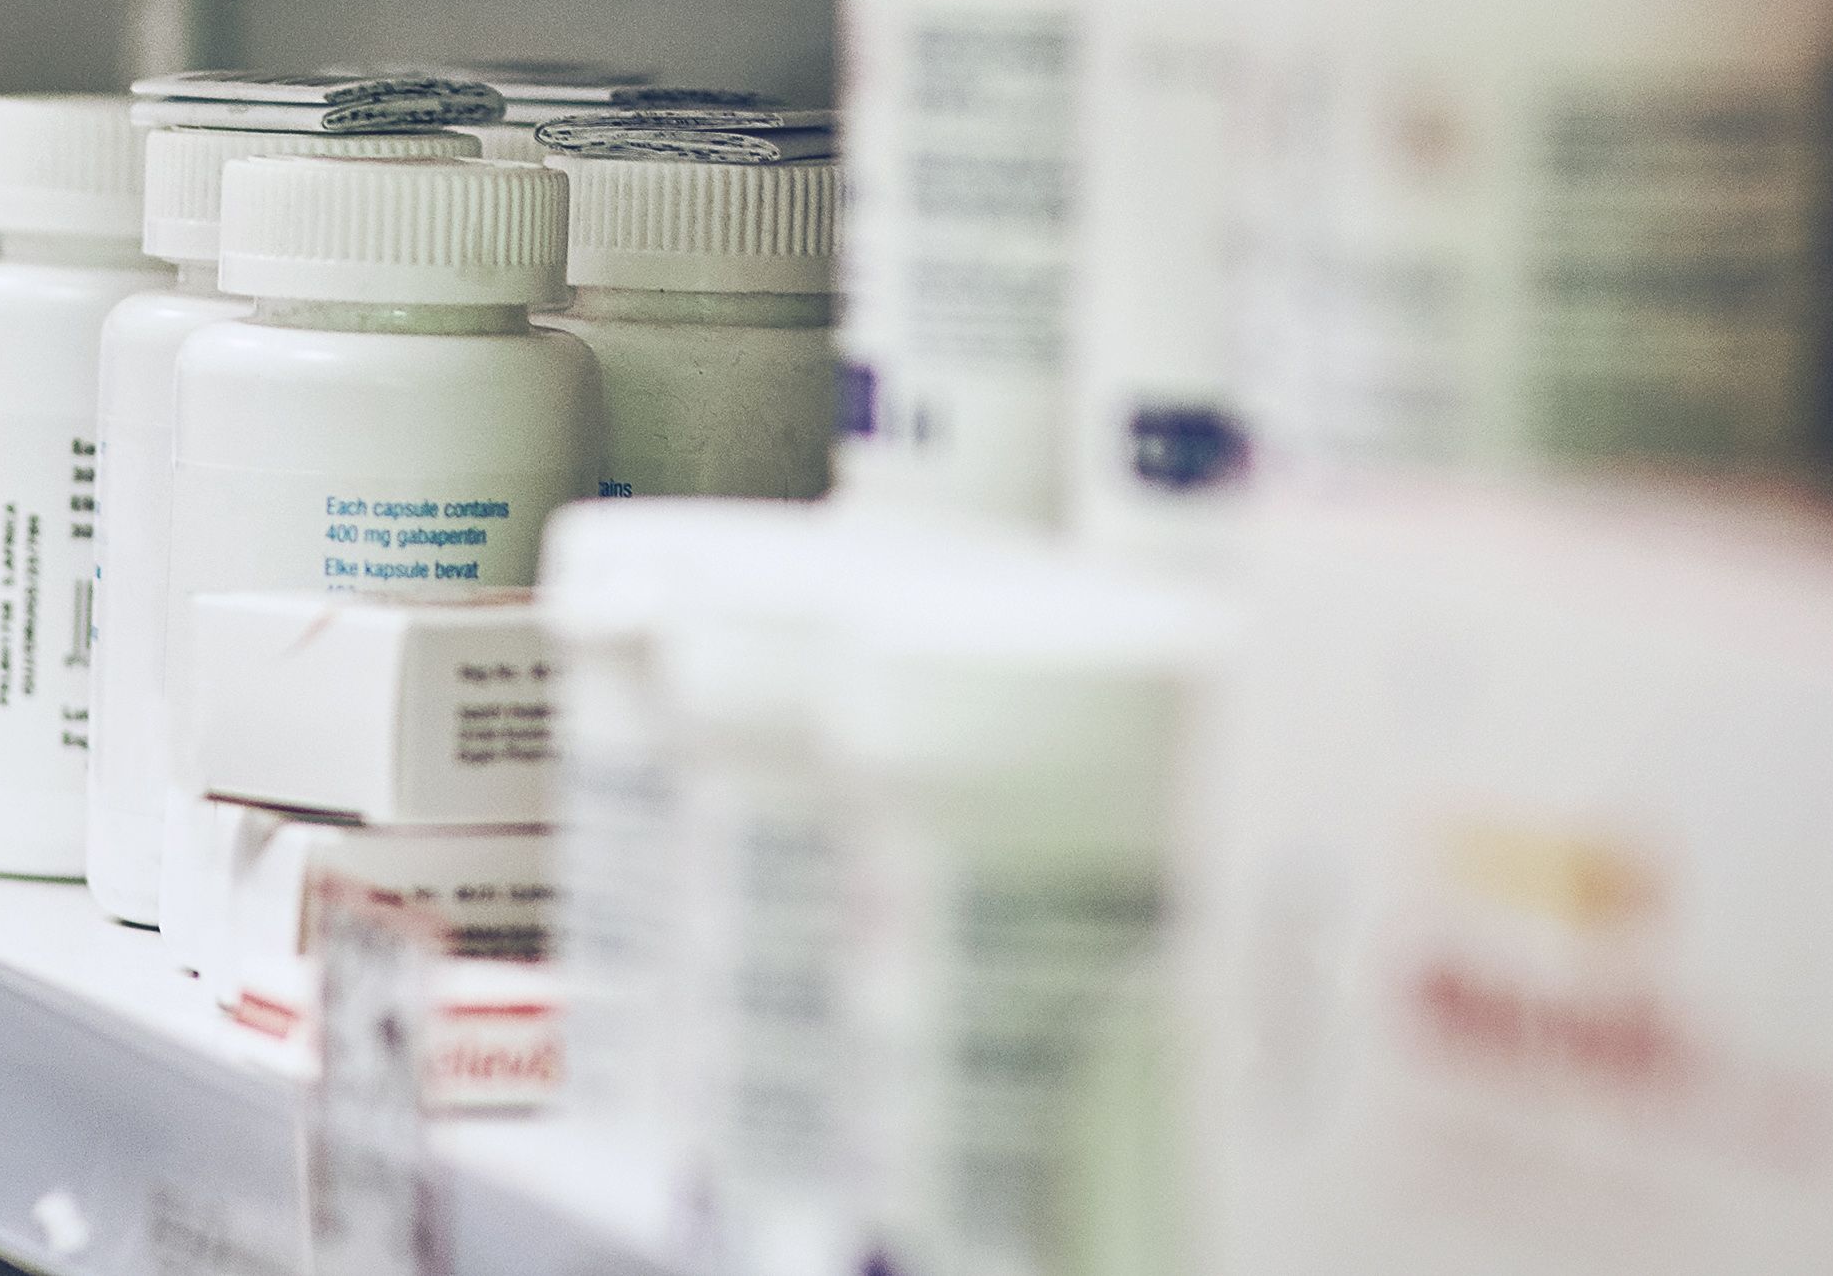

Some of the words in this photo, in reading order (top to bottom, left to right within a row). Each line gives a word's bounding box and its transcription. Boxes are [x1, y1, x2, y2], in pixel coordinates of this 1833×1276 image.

[598, 478, 632, 498] ains
[326, 496, 367, 517] Each
[373, 497, 439, 521] capsule
[444, 499, 510, 519] contains
[326, 524, 359, 544] 400
[366, 527, 391, 548] mg
[397, 526, 487, 549] gabapentin
[325, 557, 359, 577] Elke
[365, 559, 429, 581] kapsule
[434, 560, 479, 580] bevat
